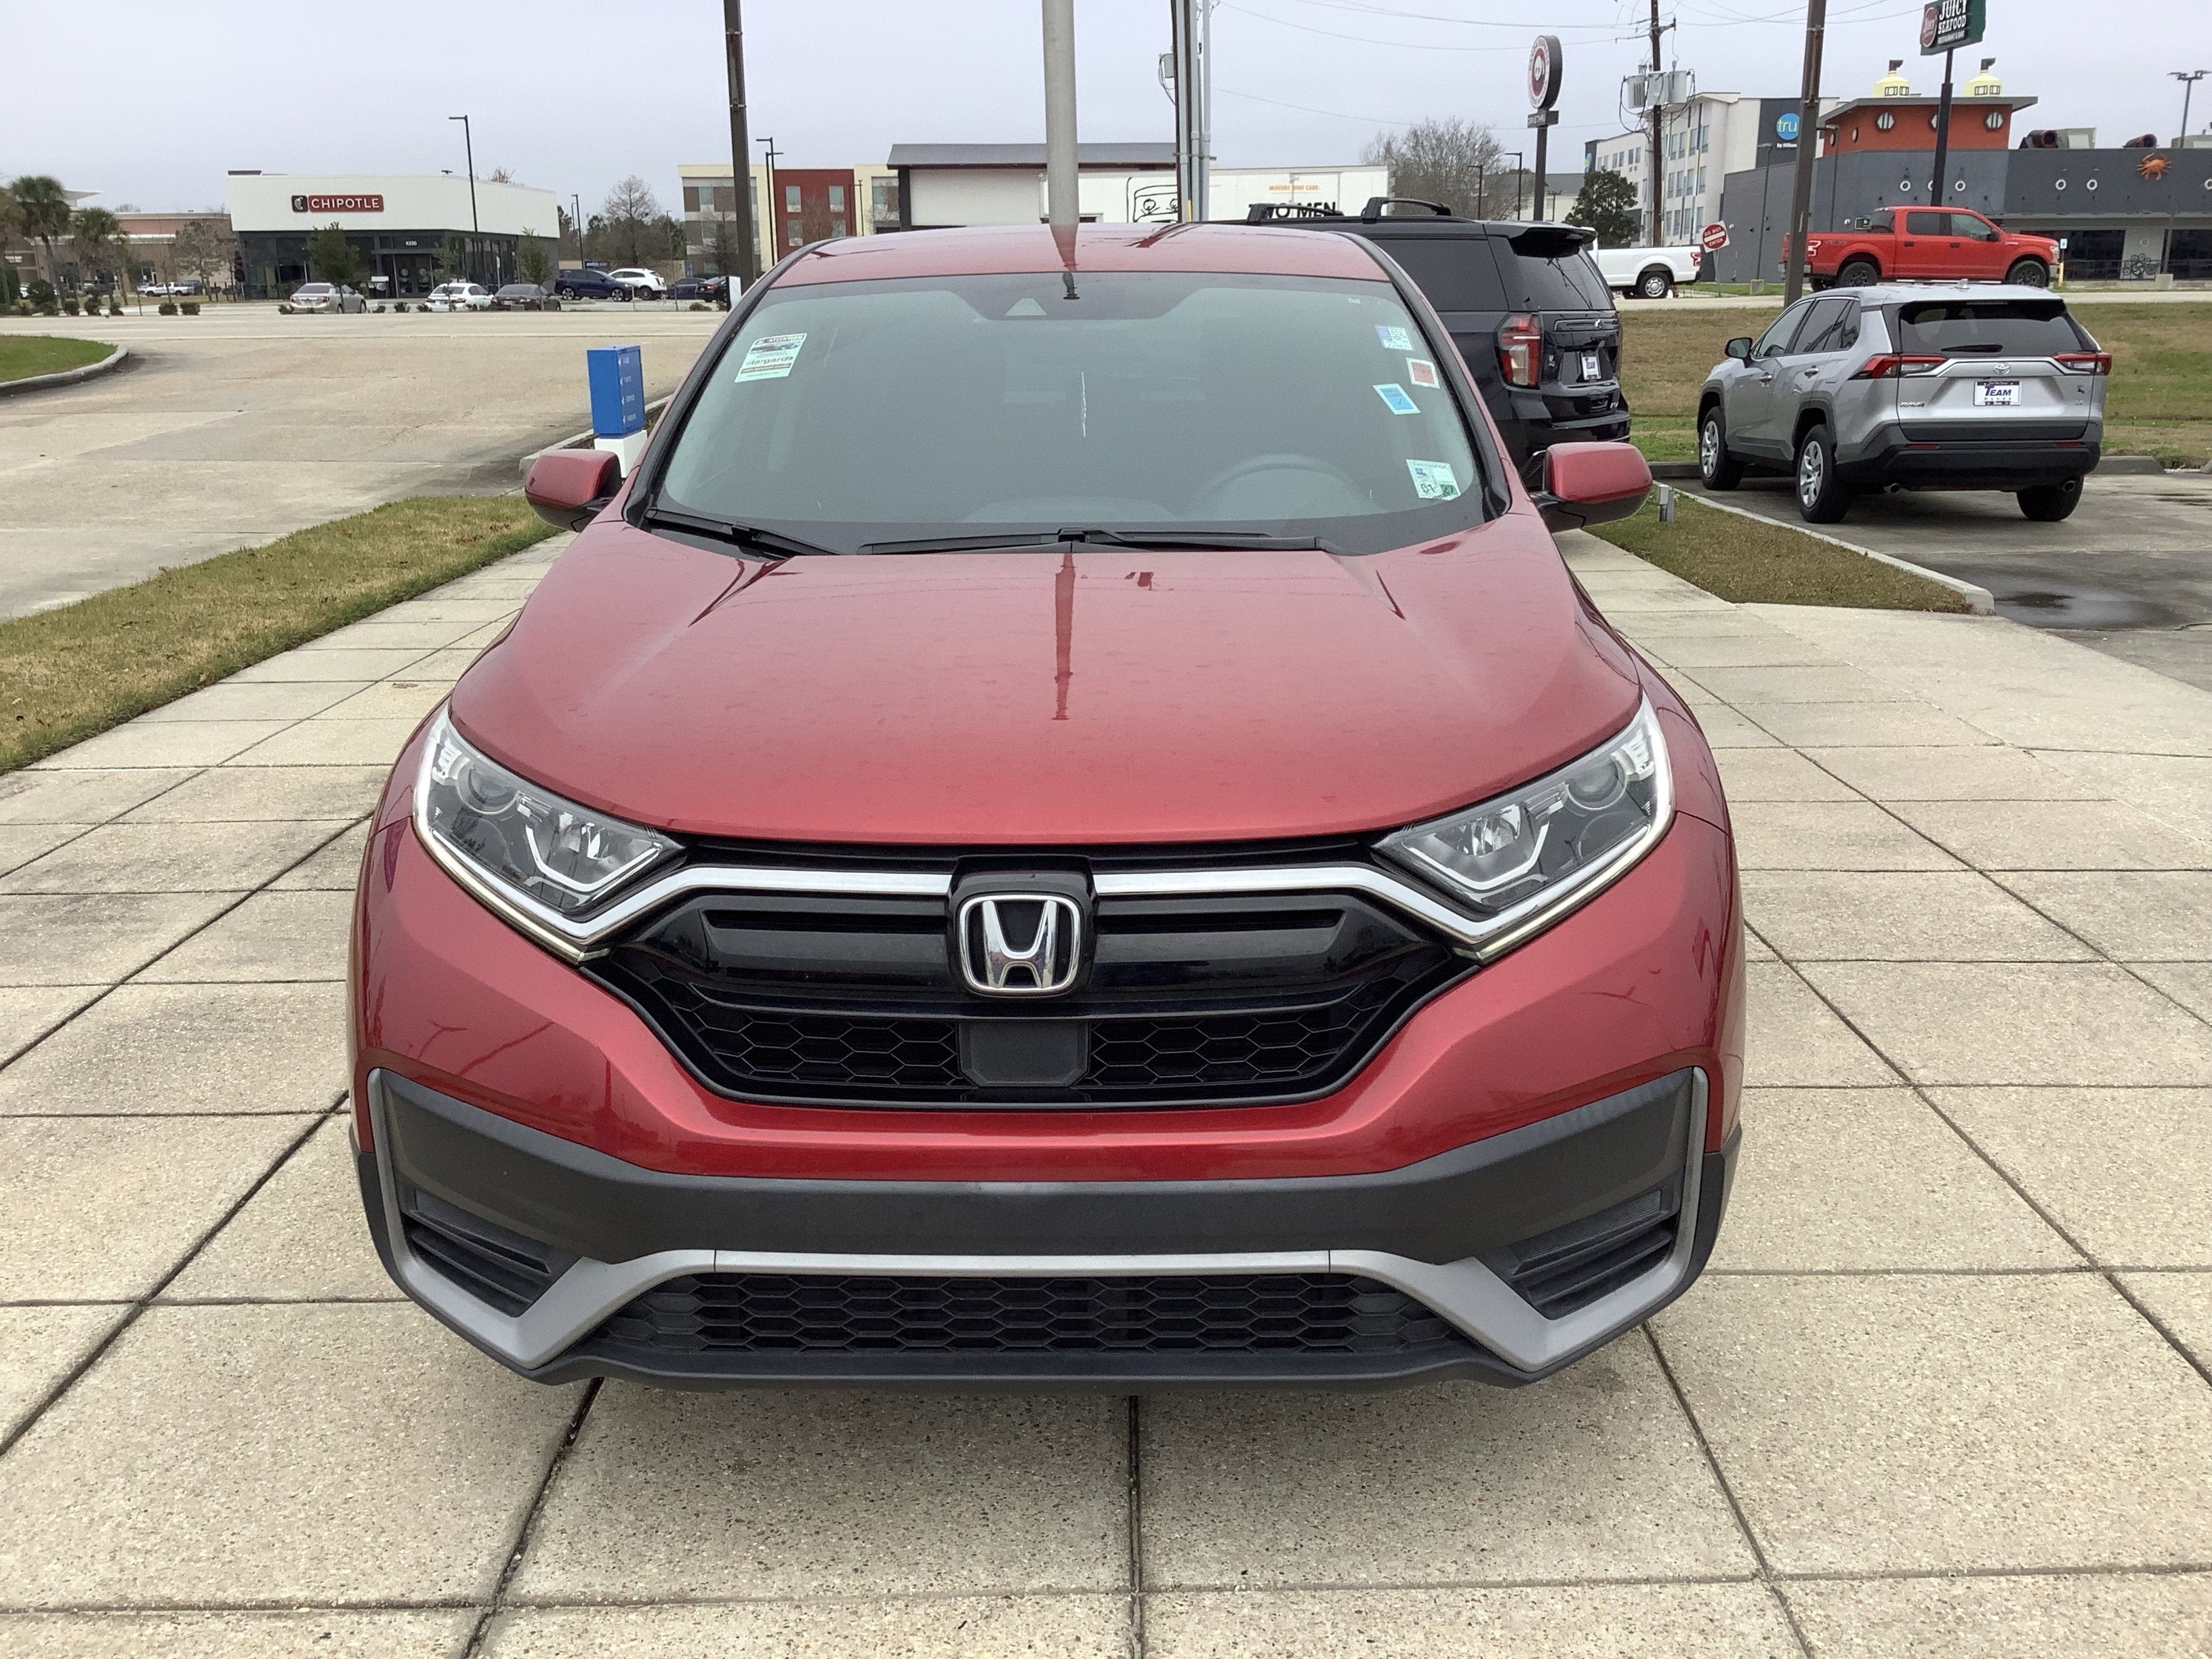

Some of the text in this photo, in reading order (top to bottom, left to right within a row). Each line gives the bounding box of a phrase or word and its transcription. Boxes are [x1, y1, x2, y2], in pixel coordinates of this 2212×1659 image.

[1939, 0, 1967, 20] JUICY
[1938, 15, 1967, 35] SEAFOOD
[1777, 119, 1797, 132] tru
[311, 198, 380, 209] CHIPOTLE
[1984, 384, 2012, 396] TEAM
